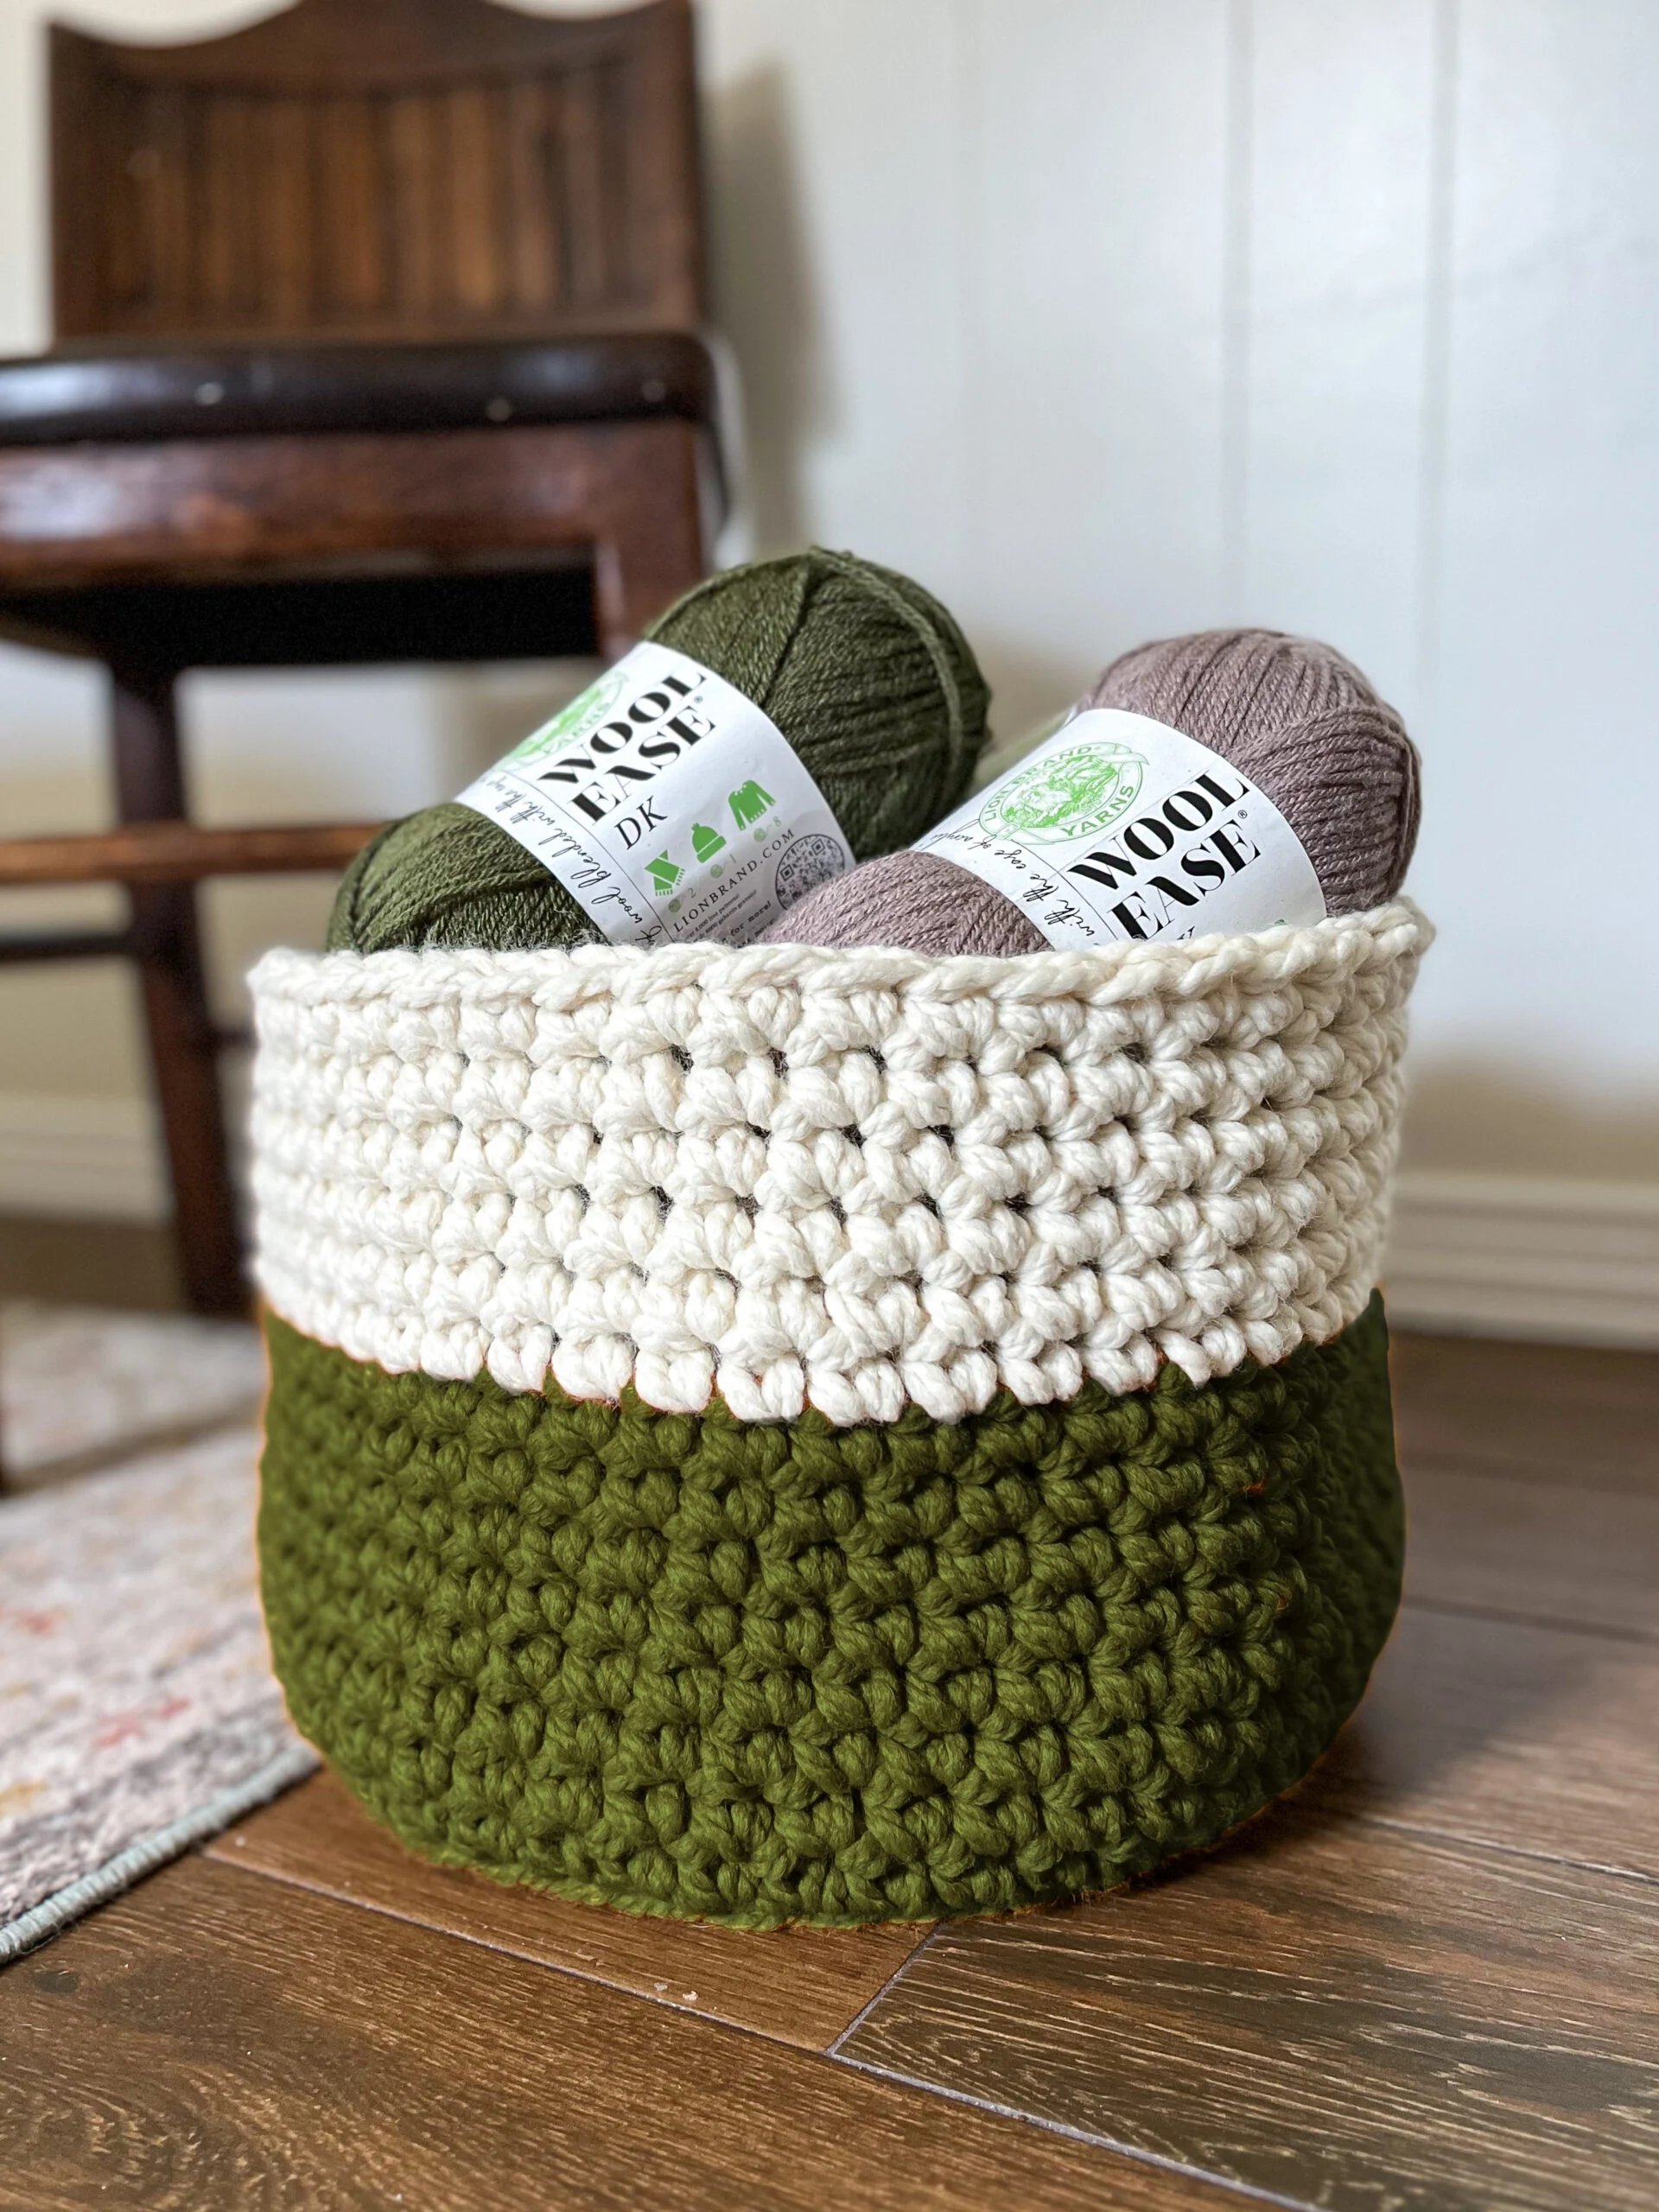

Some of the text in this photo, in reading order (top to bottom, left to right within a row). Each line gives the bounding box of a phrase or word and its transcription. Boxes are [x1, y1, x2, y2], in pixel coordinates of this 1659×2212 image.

[537, 671, 708, 784] WOOL
[984, 746, 1092, 822] LION BRAND
[510, 801, 556, 826] with
[613, 795, 668, 850] DK
[1060, 785, 1135, 836] YARNS
[1066, 770, 1250, 890] WOOL
[537, 828, 612, 888] blended
[967, 834, 997, 850] of
[994, 849, 1027, 869] ease
[673, 828, 795, 933] LIONBRAND.COM
[1022, 874, 1059, 902] the
[591, 887, 643, 924] wool
[730, 899, 772, 937] for more!
[1044, 899, 1095, 937] with
